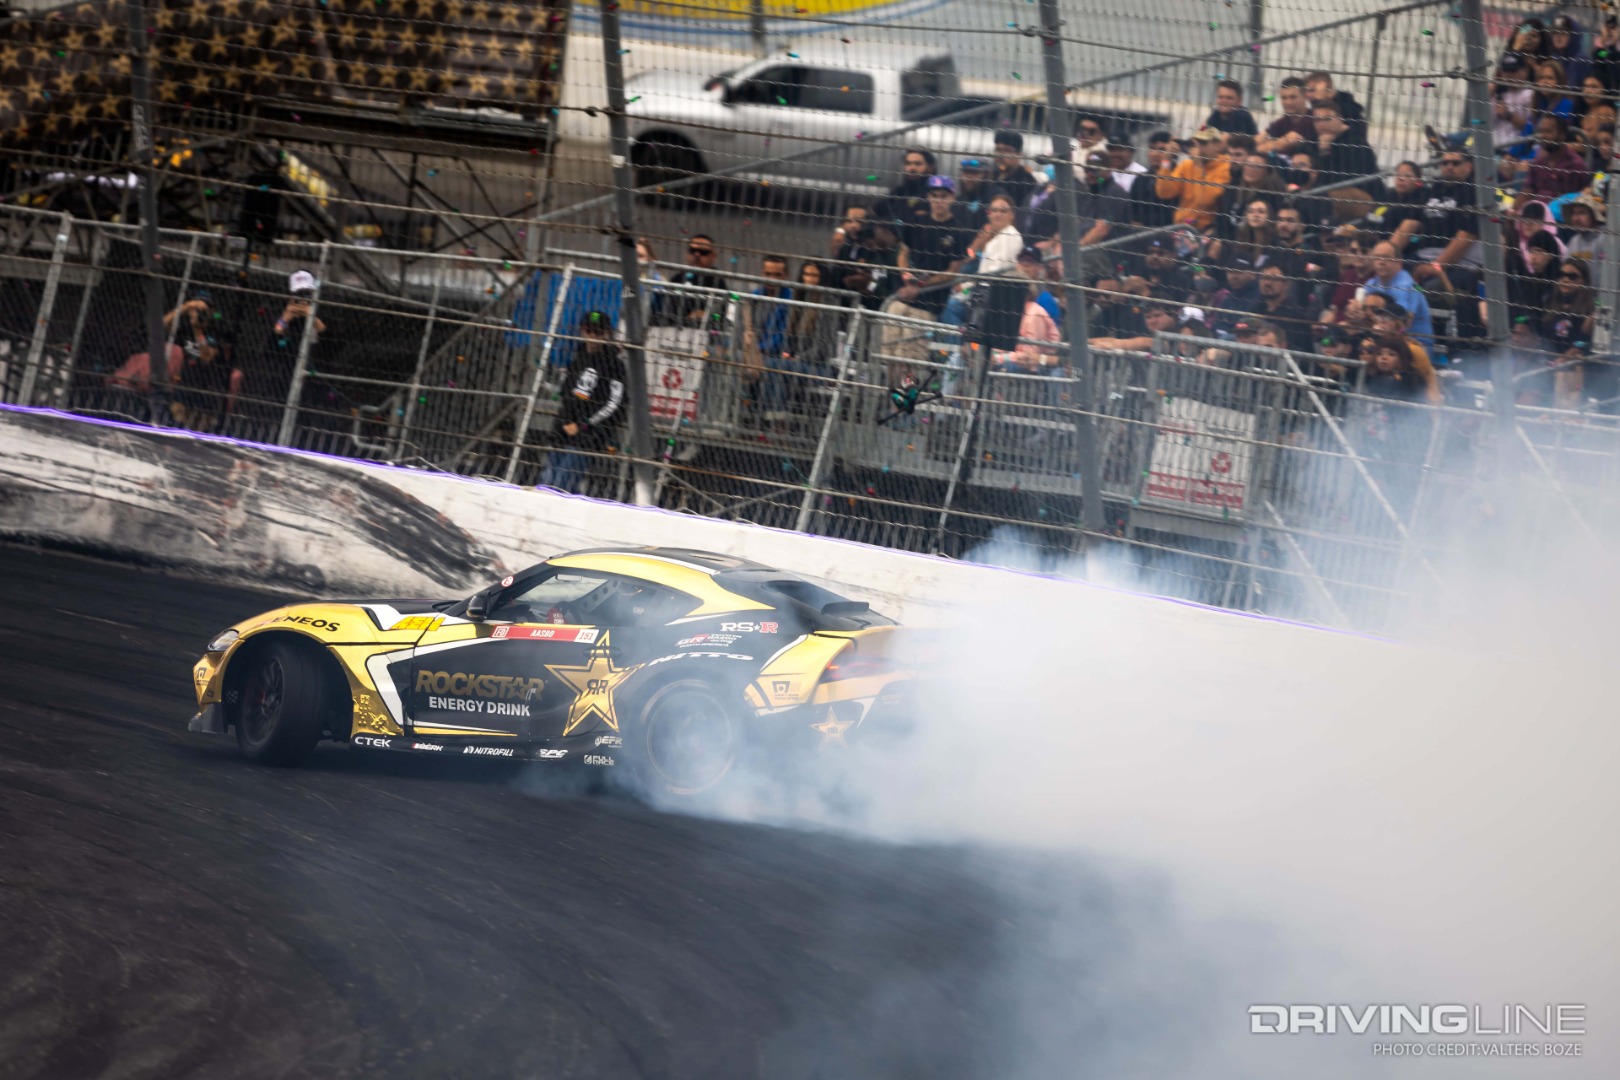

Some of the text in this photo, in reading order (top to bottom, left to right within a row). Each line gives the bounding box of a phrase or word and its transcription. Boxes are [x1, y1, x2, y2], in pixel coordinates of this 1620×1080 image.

[272, 615, 341, 632] ENEOS
[530, 629, 555, 638] AASBO
[578, 631, 594, 641] 151
[415, 669, 545, 701] ROCKSTAR
[428, 695, 531, 717] ENERGY DRINK
[354, 736, 393, 748] CTEK
[474, 746, 514, 757] NITROFILL
